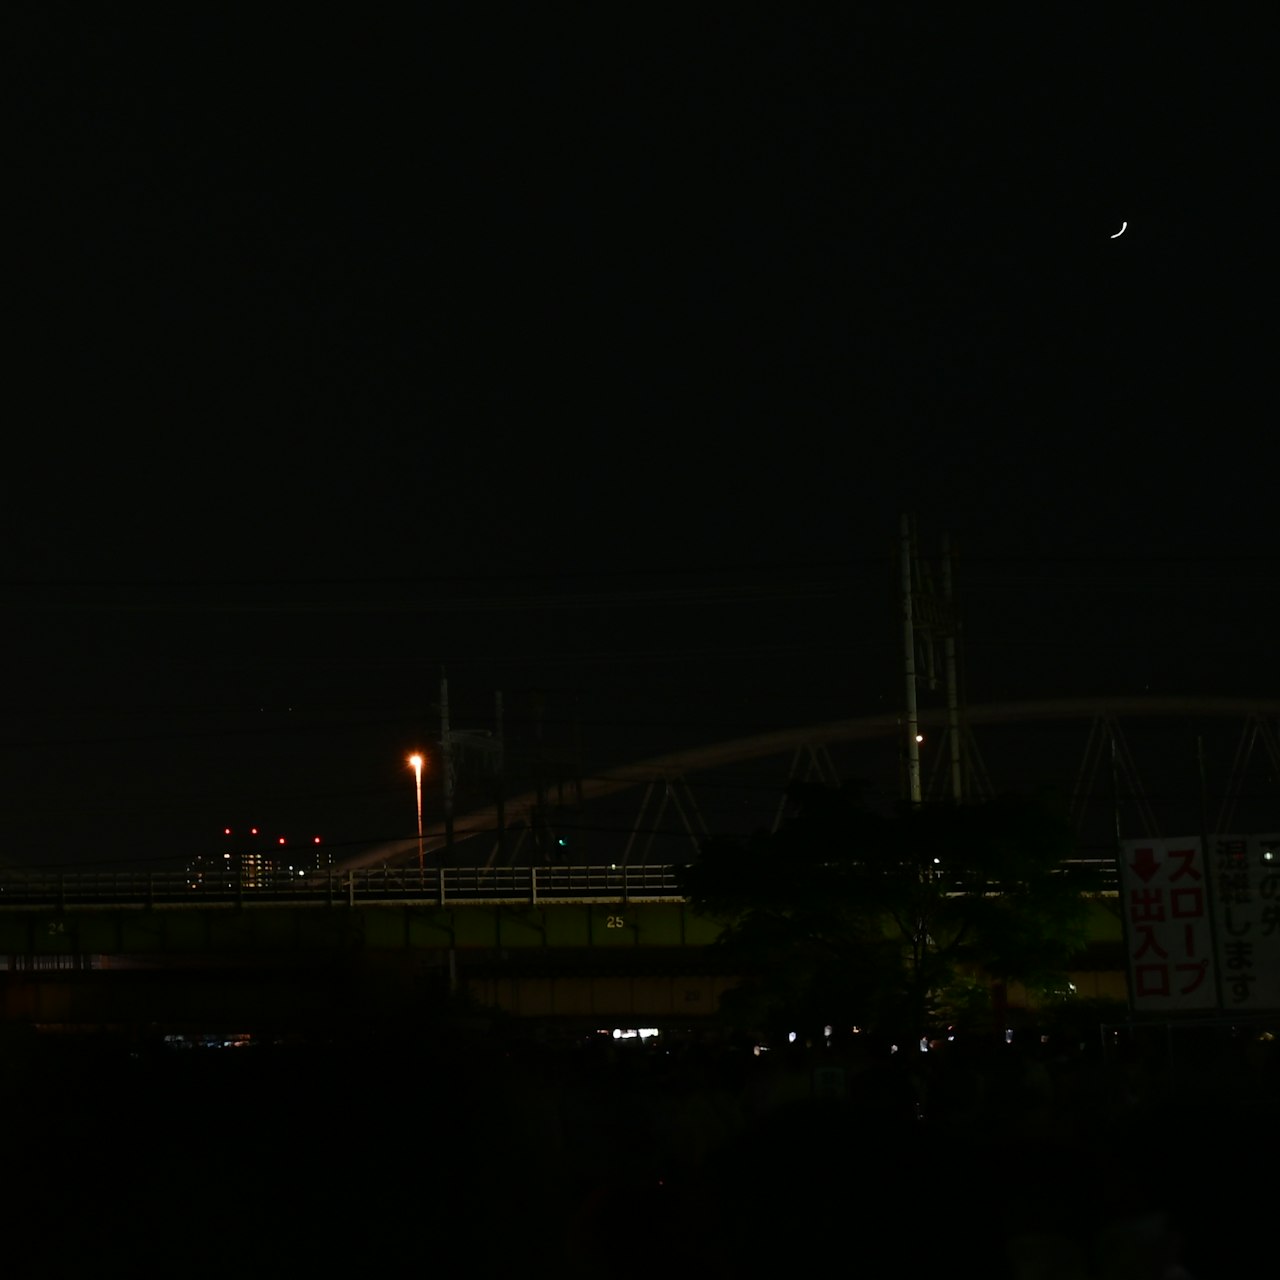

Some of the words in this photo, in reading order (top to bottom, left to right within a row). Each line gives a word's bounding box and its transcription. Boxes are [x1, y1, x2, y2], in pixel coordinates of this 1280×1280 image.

[606, 915, 624, 928] 25
[1130, 888, 1170, 996] 出入口
[1168, 850, 1209, 994] スロープ
[1216, 840, 1256, 1003] 混雑します
